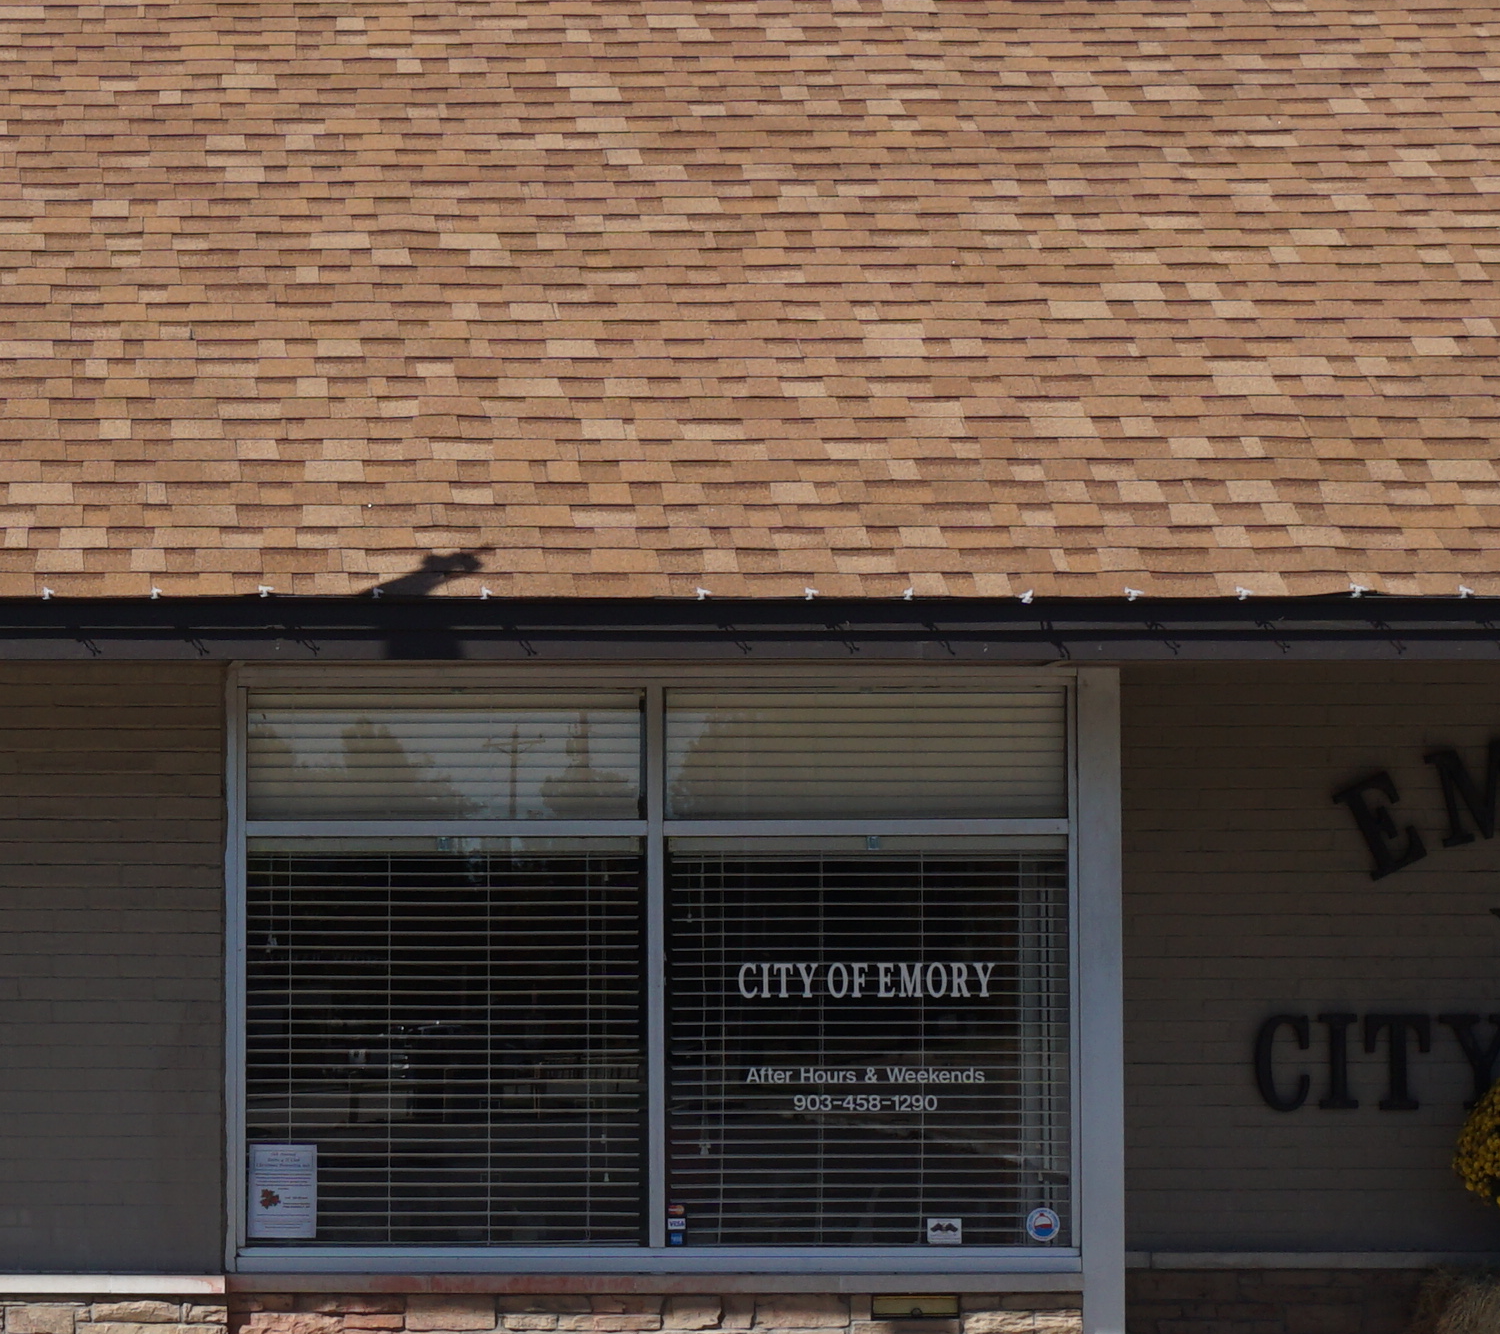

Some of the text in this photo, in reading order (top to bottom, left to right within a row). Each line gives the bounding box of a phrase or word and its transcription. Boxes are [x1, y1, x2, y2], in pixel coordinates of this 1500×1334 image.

[738, 962, 995, 998] CITY OF EMORY
[746, 1068, 985, 1083] After Hours & Weekends
[794, 1095, 938, 1111] 903-458-1290
